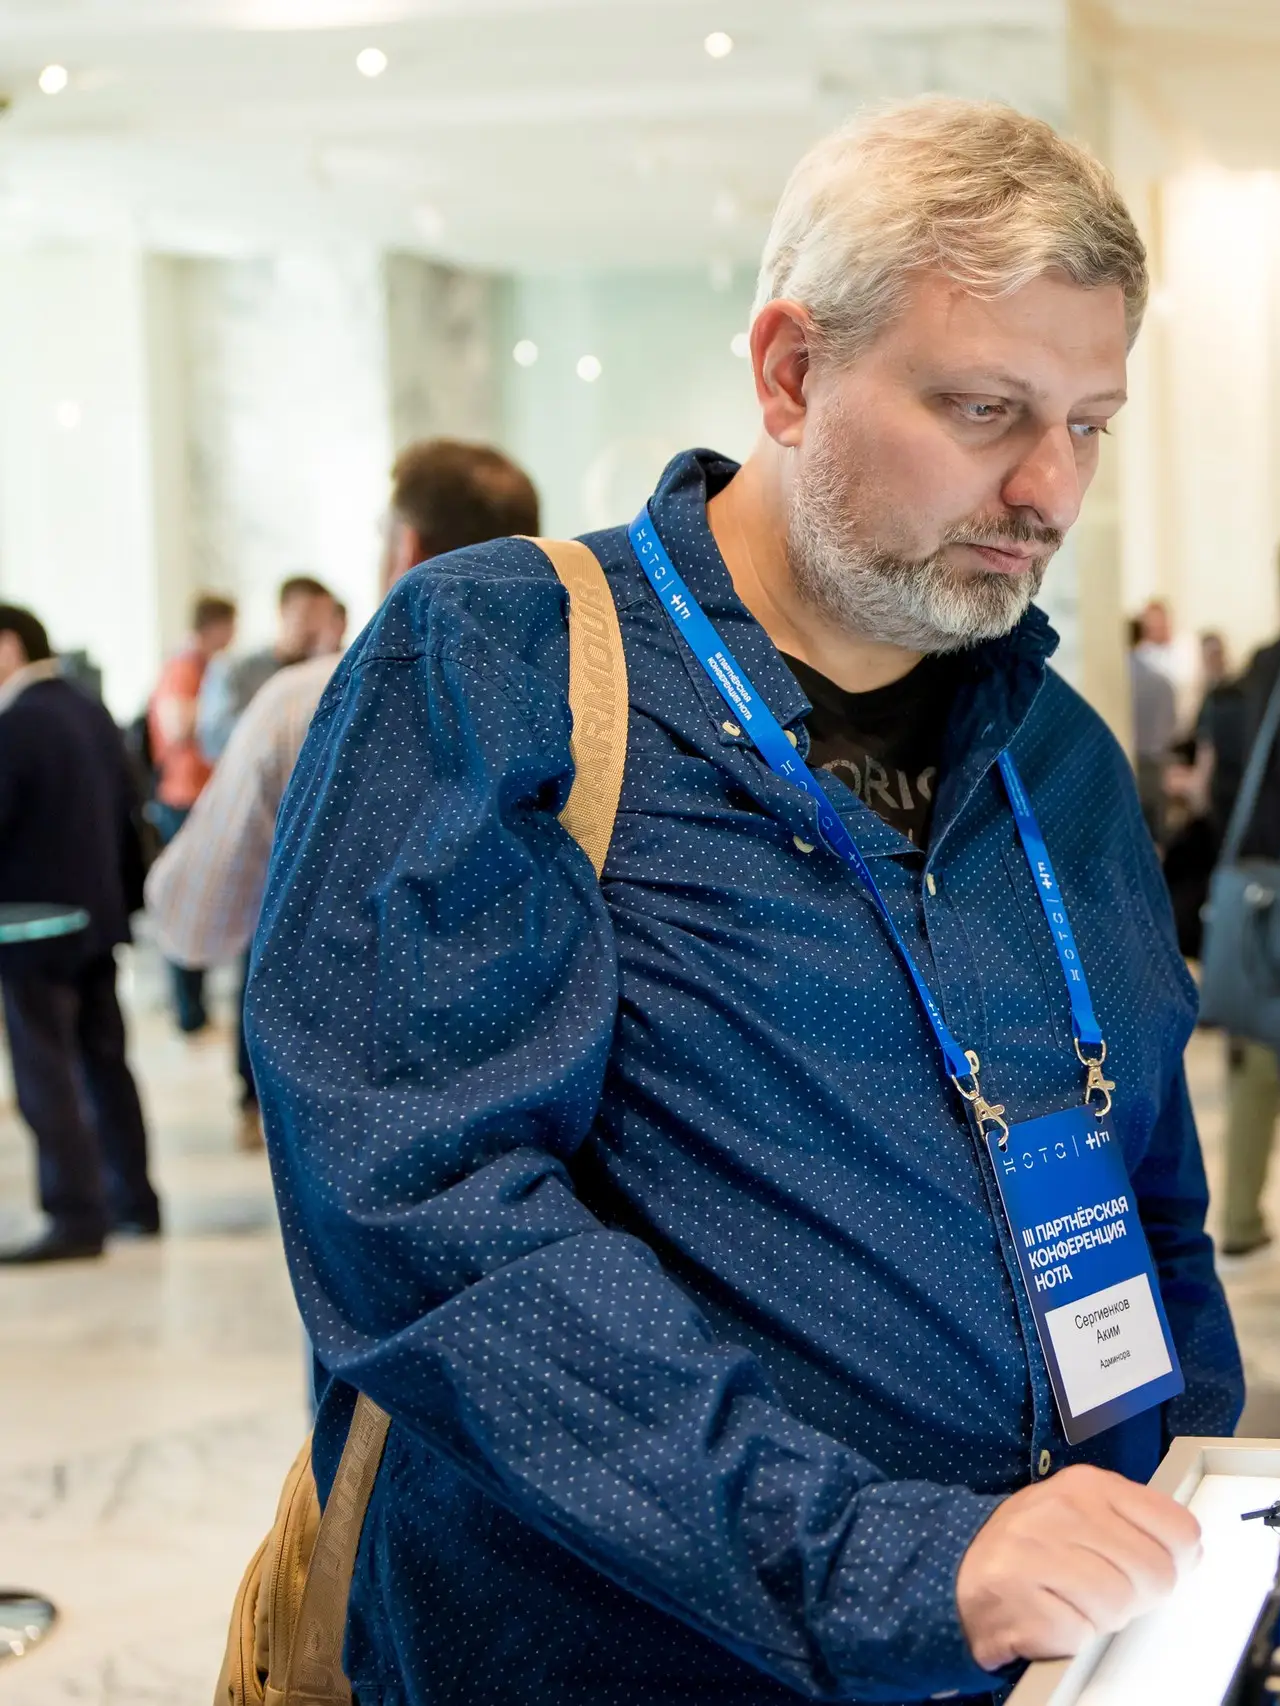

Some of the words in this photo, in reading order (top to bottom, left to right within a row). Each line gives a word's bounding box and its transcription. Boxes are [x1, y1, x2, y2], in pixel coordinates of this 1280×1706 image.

[736, 701, 752, 721] НОТА
[1022, 1228, 1035, 1248] III
[1035, 1196, 1129, 1243] ПАРТНЁРСКАЯ
[1028, 1220, 1127, 1270] КОНФЕРЕНЦИЯ
[1034, 1264, 1073, 1292] НОТА
[1075, 1299, 1130, 1329] Сергиенков
[1097, 1325, 1121, 1343] Аким
[1100, 1350, 1131, 1369] Админора
